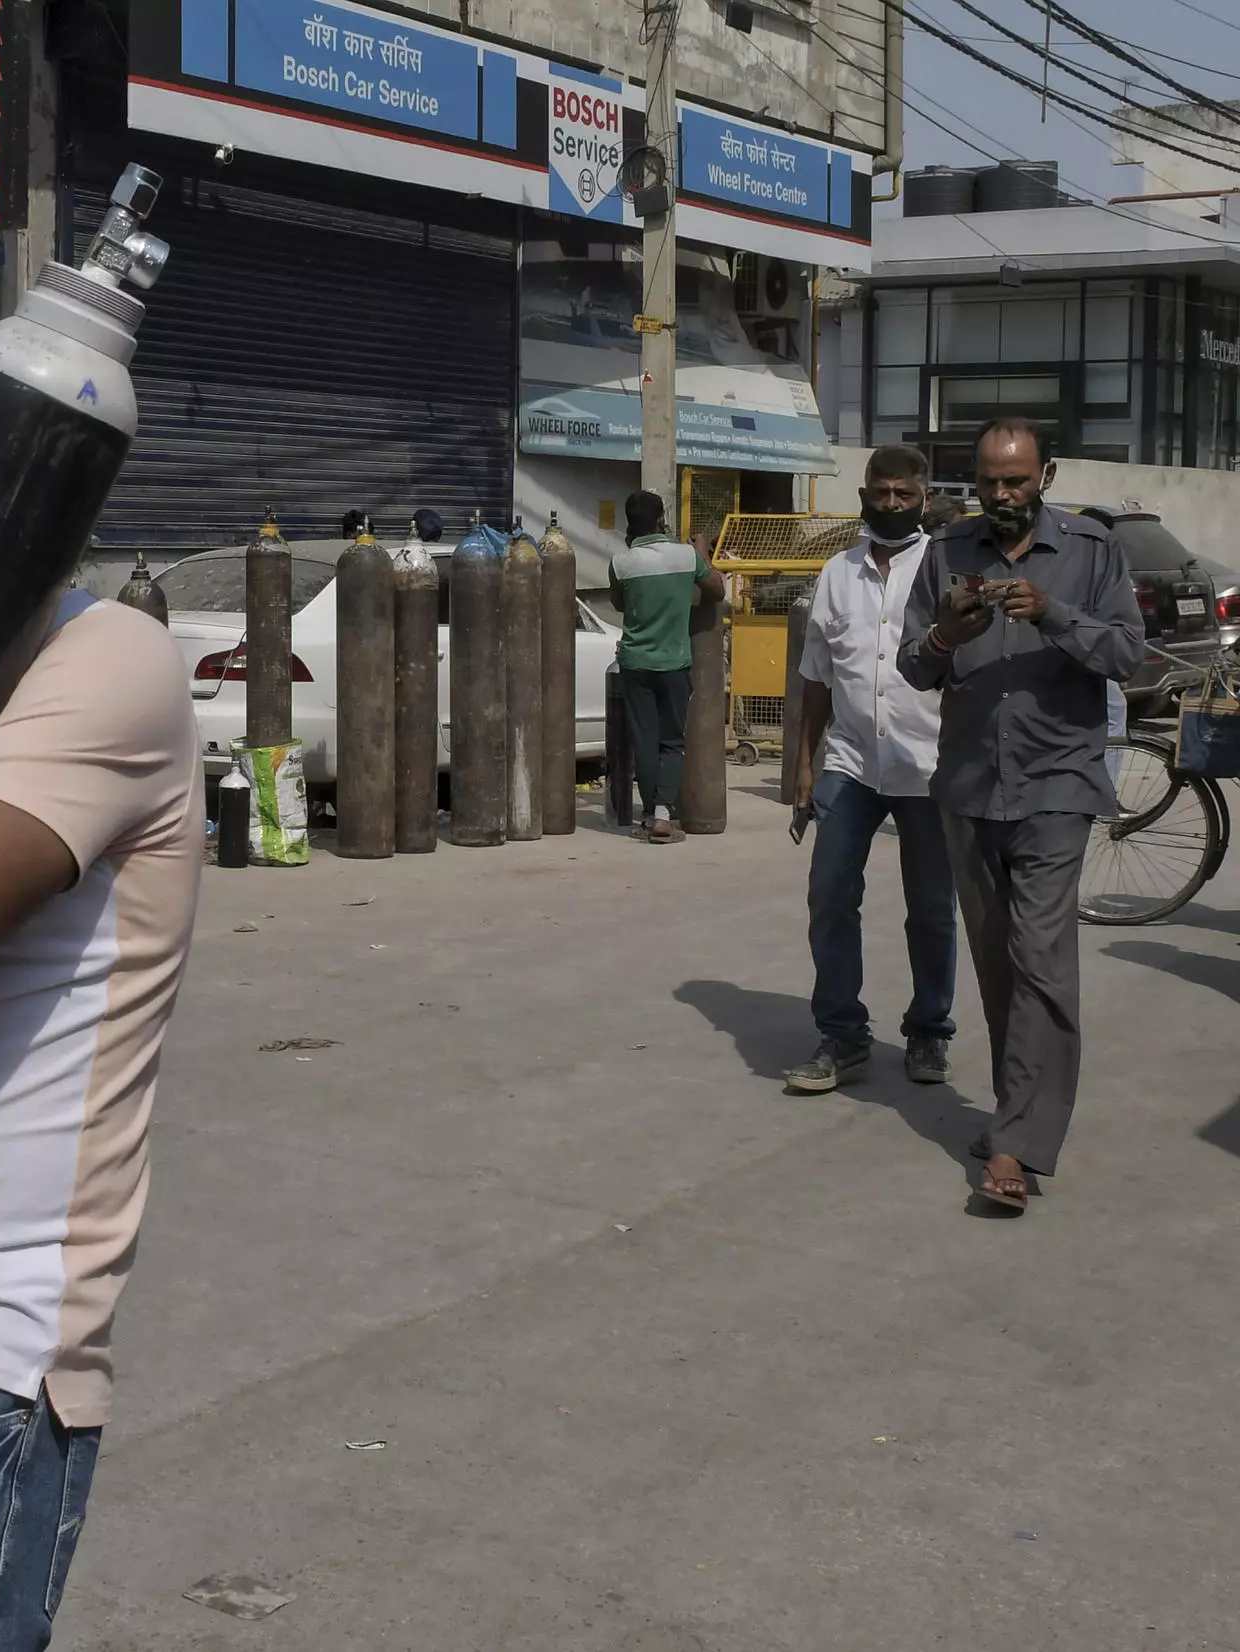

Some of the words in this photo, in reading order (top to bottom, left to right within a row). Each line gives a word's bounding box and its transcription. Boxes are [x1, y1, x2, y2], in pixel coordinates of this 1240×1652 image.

[303, 14, 337, 52] बॉश
[344, 28, 374, 61] कार
[379, 36, 423, 74] सर्विस
[282, 54, 340, 92] Bosch
[344, 70, 375, 101] Car
[378, 79, 439, 117] Service
[553, 86, 620, 134] BOSCH
[553, 126, 620, 169] Service
[707, 163, 742, 191] Wheel
[744, 173, 773, 199] Force
[775, 181, 808, 206] Centre
[528, 416, 565, 434] WHEEL
[567, 420, 601, 437] FORCE
